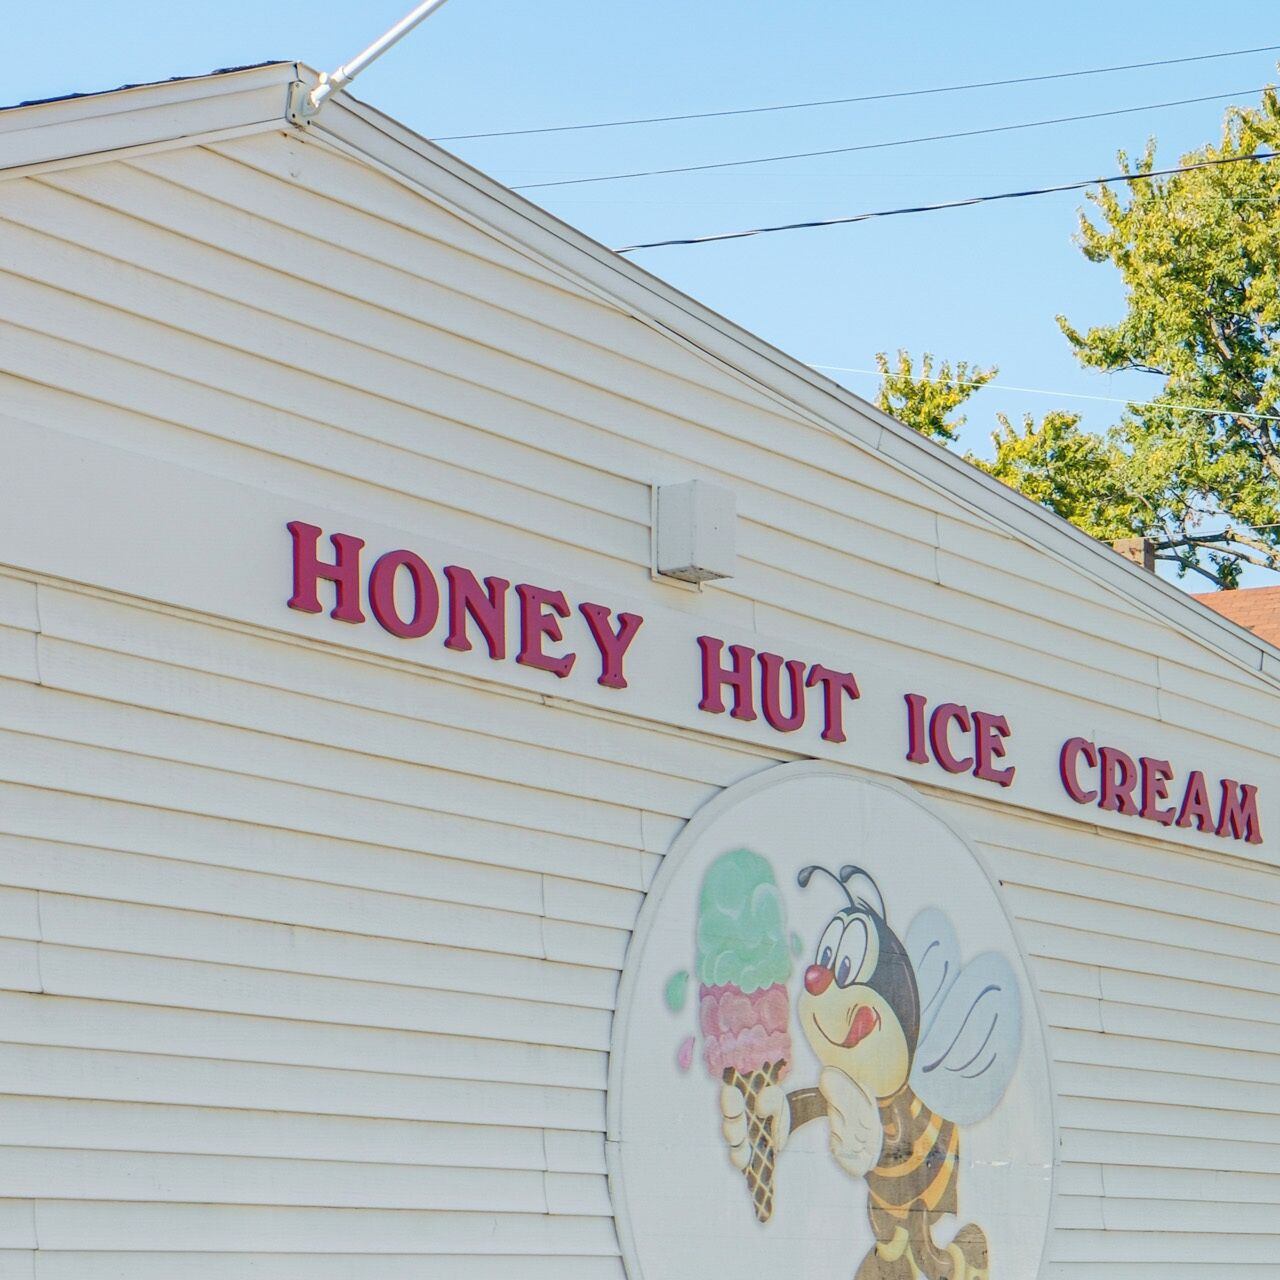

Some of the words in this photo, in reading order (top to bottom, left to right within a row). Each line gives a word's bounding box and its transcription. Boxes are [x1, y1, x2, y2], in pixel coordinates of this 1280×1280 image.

[287, 521, 643, 689] HONEY
[697, 635, 860, 743] HUT
[904, 693, 1015, 787] ICE
[1061, 737, 1263, 844] CREAM
